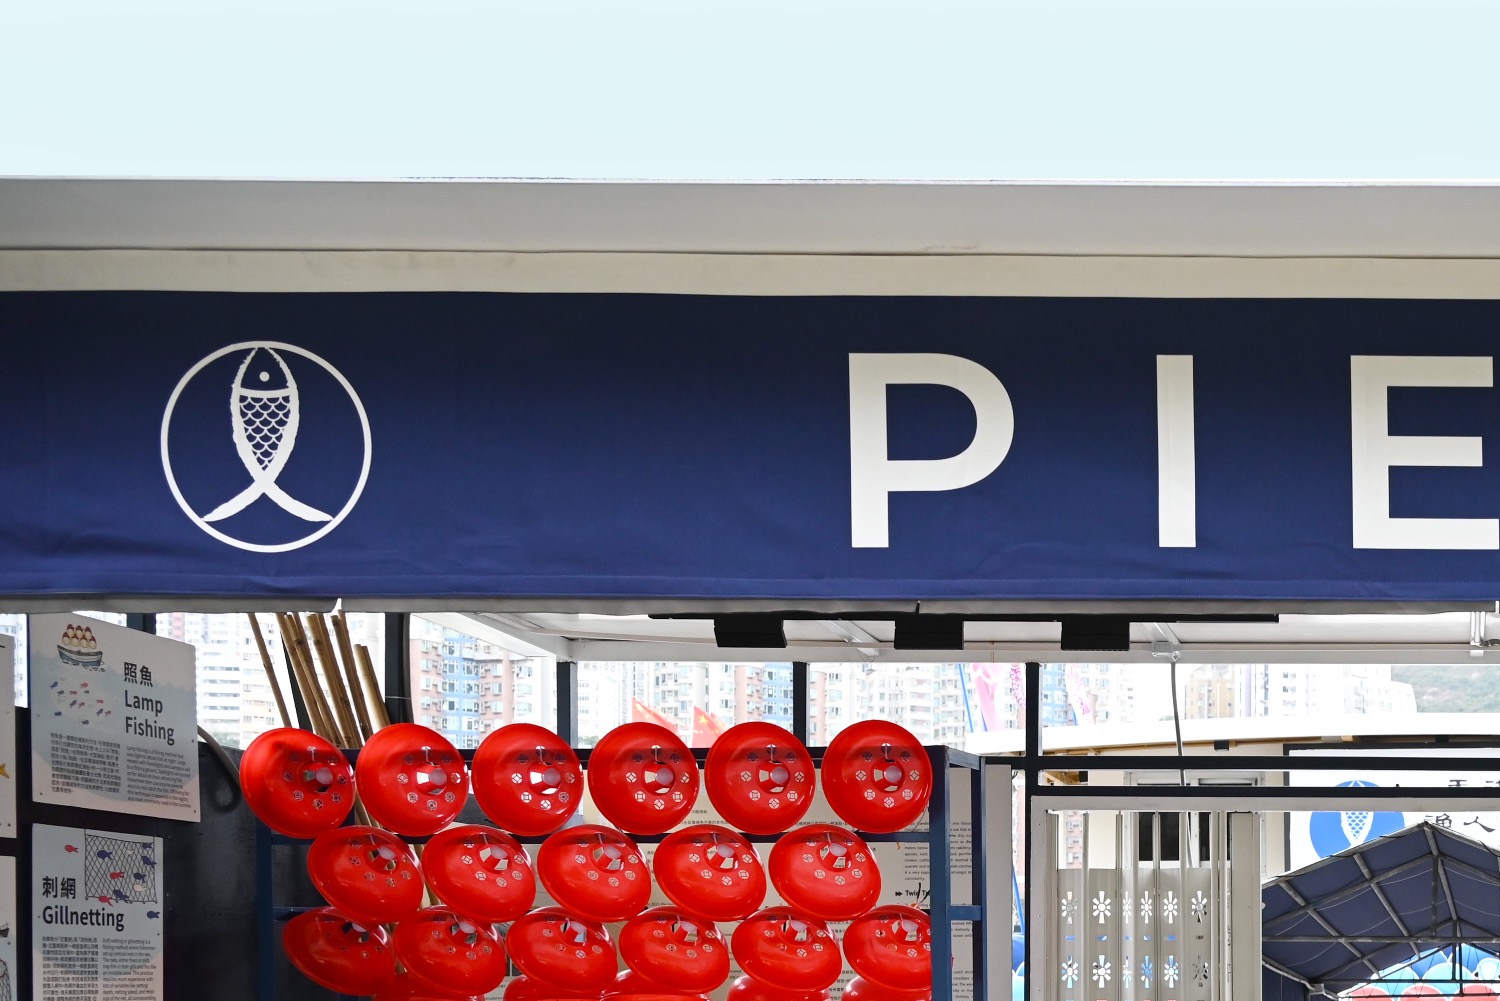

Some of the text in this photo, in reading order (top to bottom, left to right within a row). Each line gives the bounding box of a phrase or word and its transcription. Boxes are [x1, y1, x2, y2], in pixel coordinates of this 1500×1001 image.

[124, 662, 153, 687] 照魚
[125, 690, 163, 716] Lamp
[125, 717, 174, 745] Fishing
[42, 876, 76, 899] 刺網
[42, 906, 124, 931] Gillnetting
